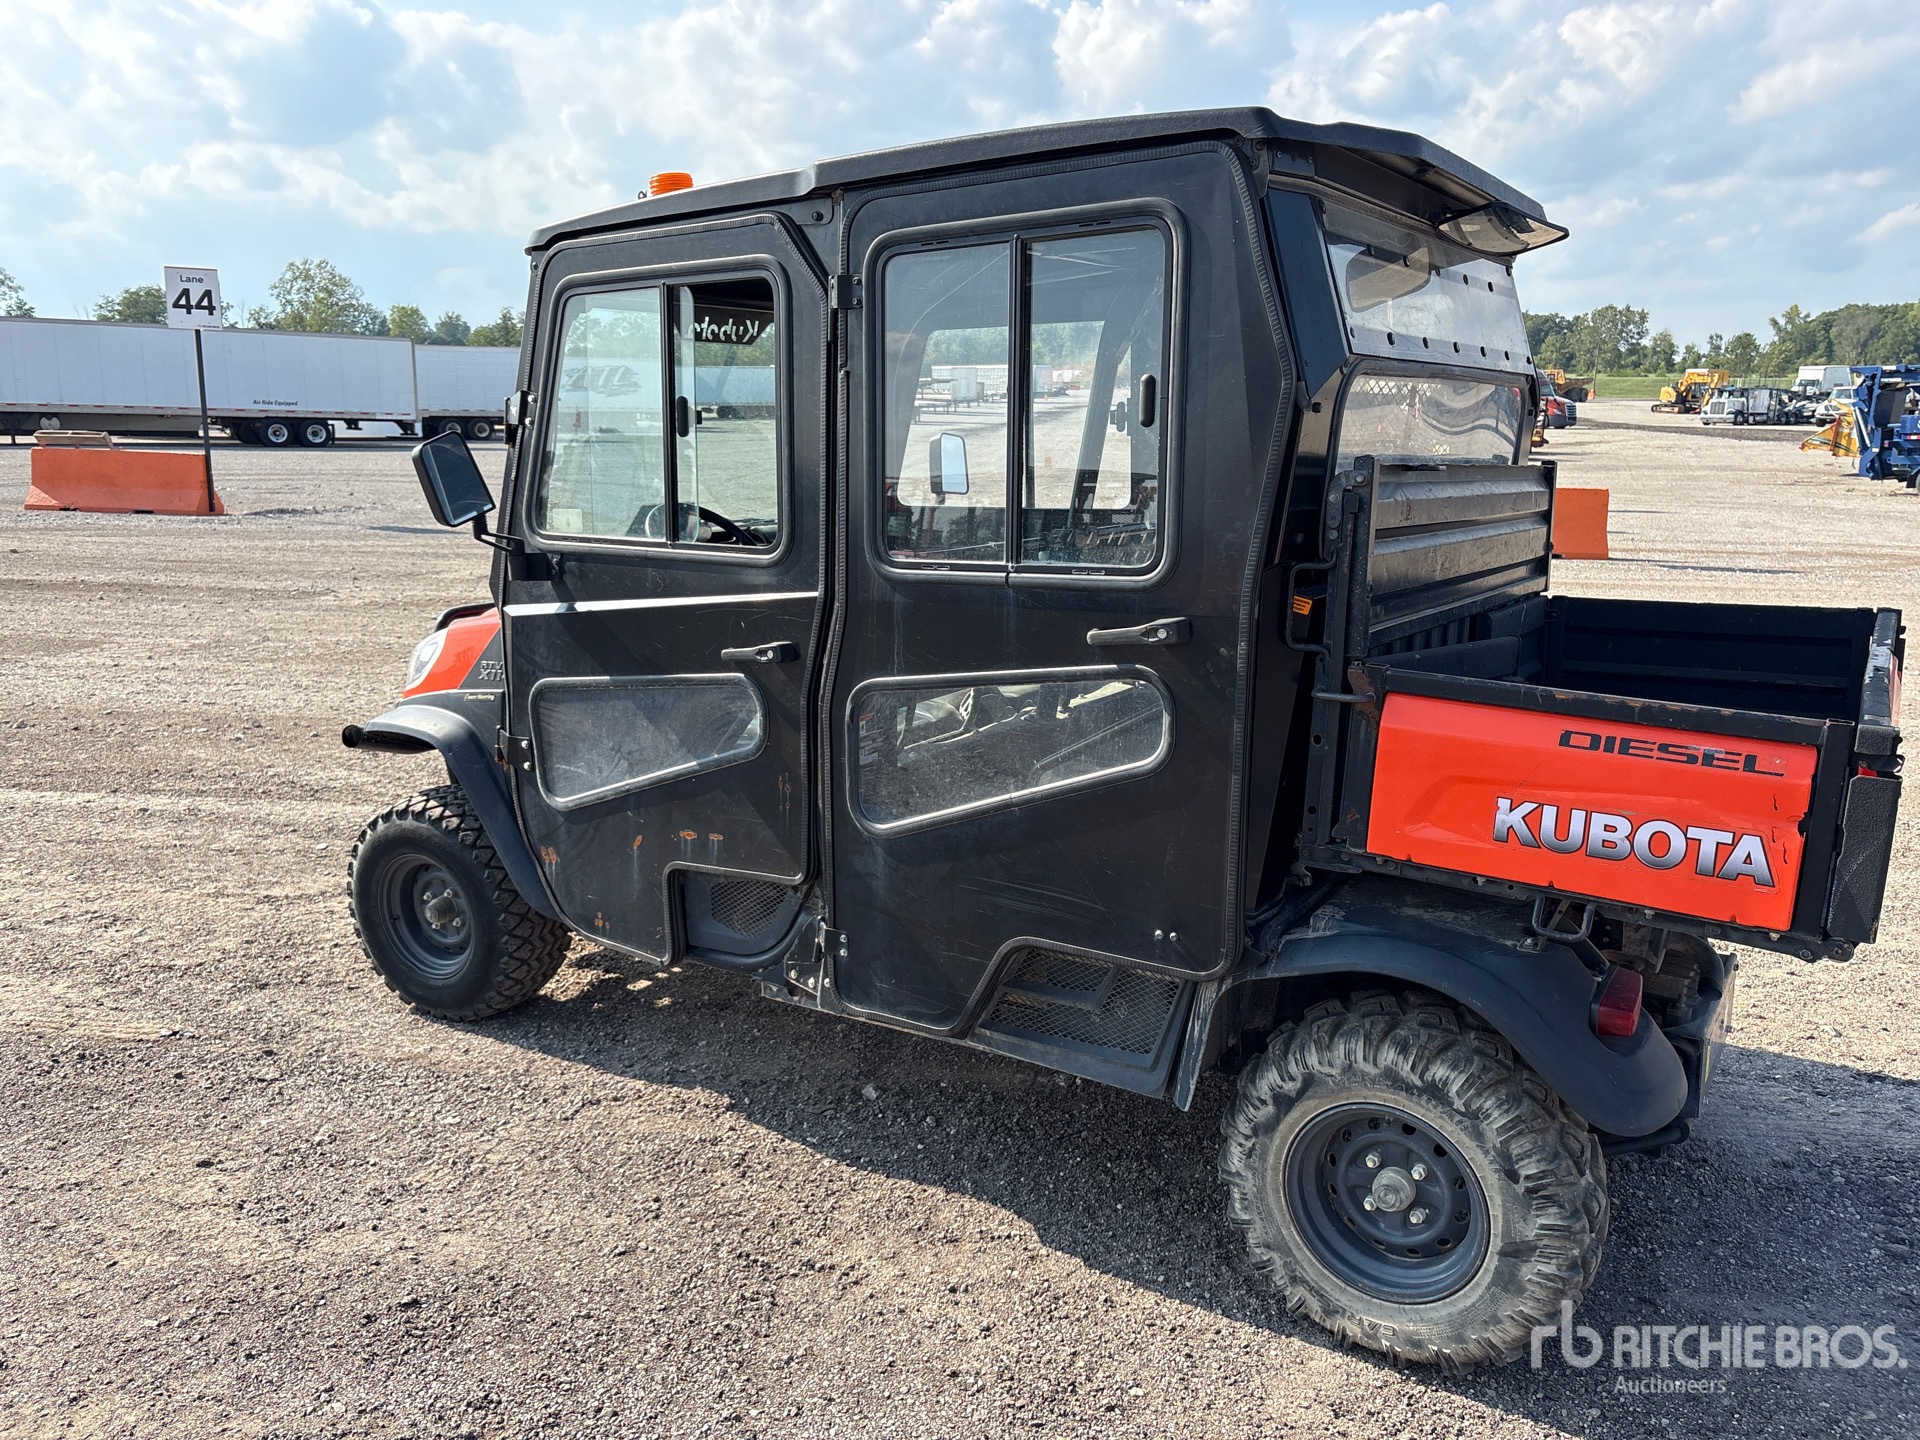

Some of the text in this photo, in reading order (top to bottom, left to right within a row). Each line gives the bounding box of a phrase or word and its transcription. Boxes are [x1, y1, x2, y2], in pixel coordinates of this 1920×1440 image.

[180, 274, 204, 284] Lane
[172, 287, 216, 316] 44
[480, 660, 504, 669] RTV
[1559, 729, 1785, 777] DIESEL
[1493, 797, 1775, 887] KUBOTA
